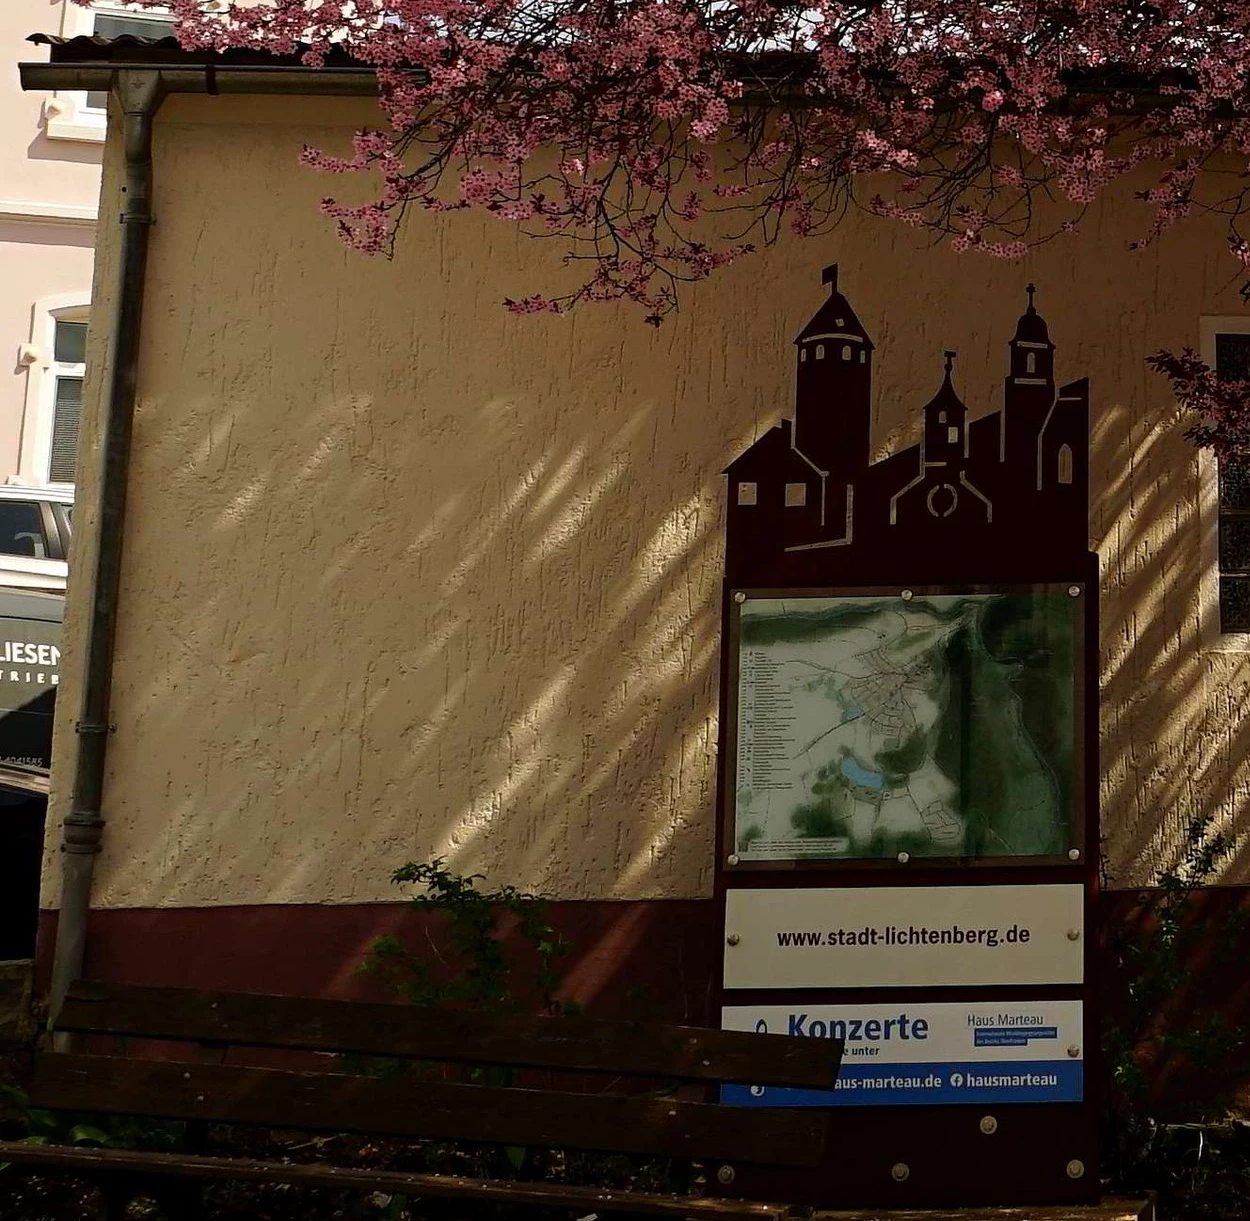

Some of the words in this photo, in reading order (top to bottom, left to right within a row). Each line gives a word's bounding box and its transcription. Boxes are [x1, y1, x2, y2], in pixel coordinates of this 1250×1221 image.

[777, 924, 1030, 948] www.stadt-lichtenberg.de
[788, 1014, 928, 1041] Konzerte
[967, 1014, 994, 1026] Haus
[998, 1013, 1044, 1025] Marteau
[851, 1046, 880, 1056] unter
[834, 1074, 942, 1090] aus-marteau.de
[966, 1073, 1057, 1087] hausmarteau
